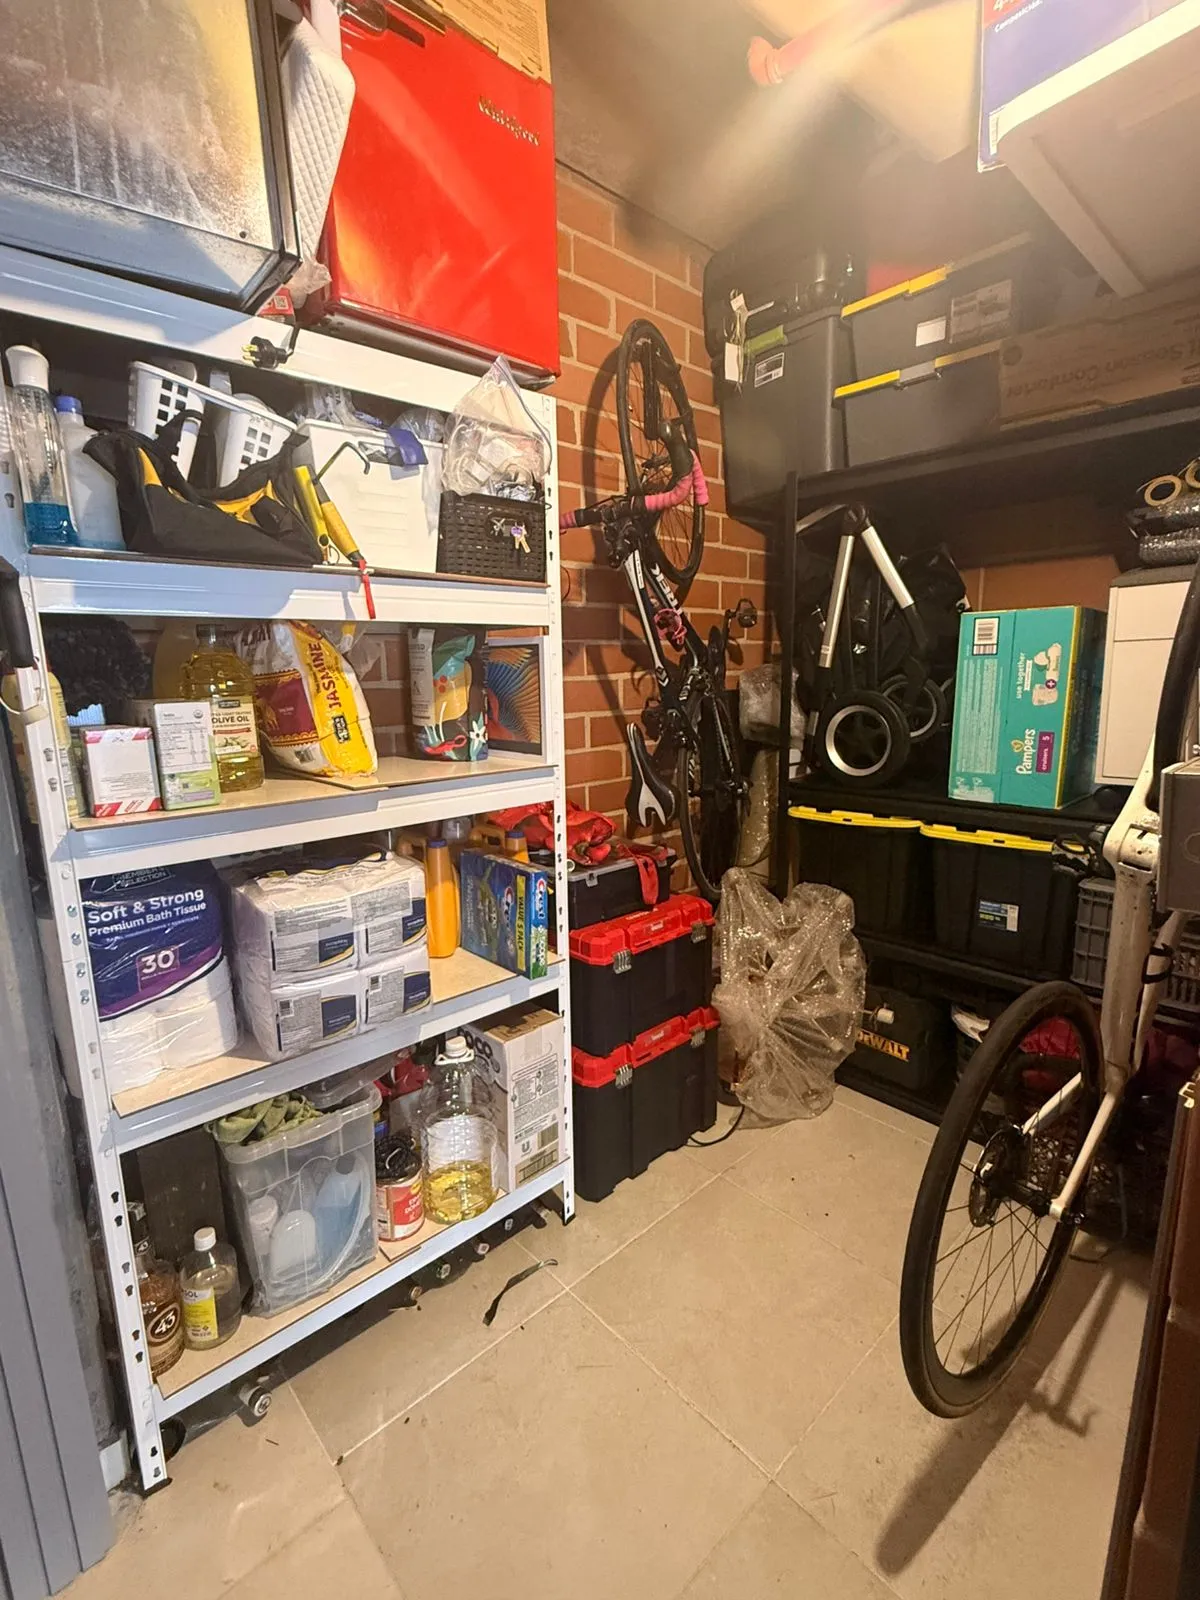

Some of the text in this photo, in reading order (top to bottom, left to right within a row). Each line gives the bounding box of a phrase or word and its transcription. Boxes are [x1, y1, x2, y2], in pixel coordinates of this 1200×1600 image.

[308, 641, 342, 709] JASMINE
[1015, 652, 1025, 683] together
[211, 714, 250, 724] OLIVE OIL
[1015, 728, 1036, 775] Pampers
[87, 888, 205, 924] Soft & Strong
[535, 877, 547, 919] Crest
[88, 917, 145, 937] Premium
[146, 910, 173, 924] Bath
[174, 901, 207, 916] Tissue
[140, 950, 175, 975] 30
[154, 1311, 176, 1336] 43
